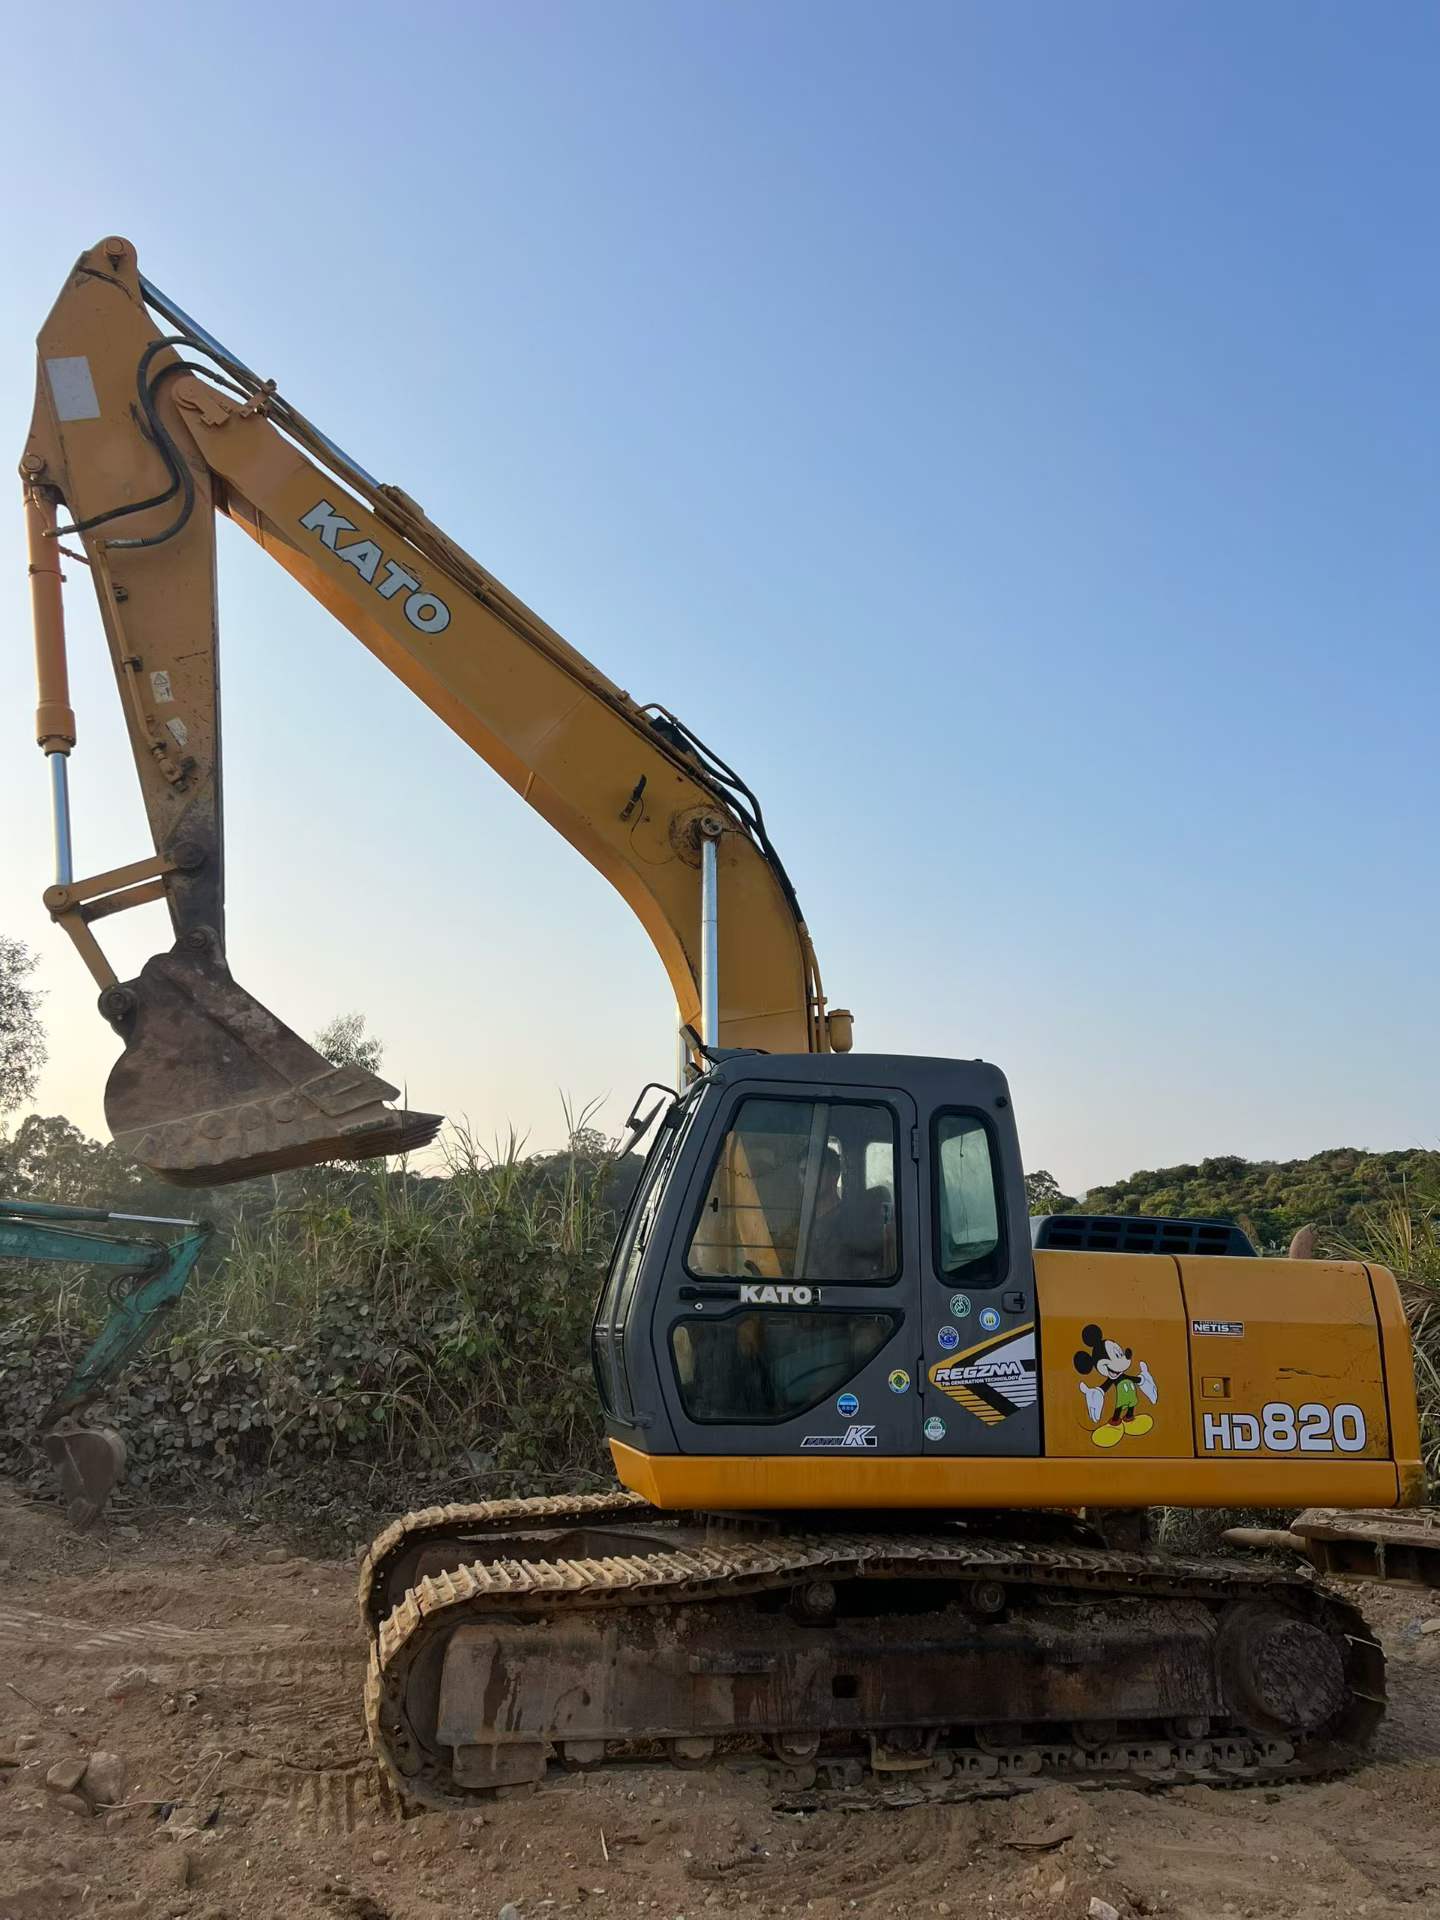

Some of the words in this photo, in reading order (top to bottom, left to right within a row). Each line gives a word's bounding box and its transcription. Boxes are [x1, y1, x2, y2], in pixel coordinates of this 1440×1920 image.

[299, 499, 451, 634] KATO
[740, 1285, 812, 1305] KATO
[1194, 1323, 1230, 1332] NETIS
[1203, 1402, 1366, 1452] HD820
